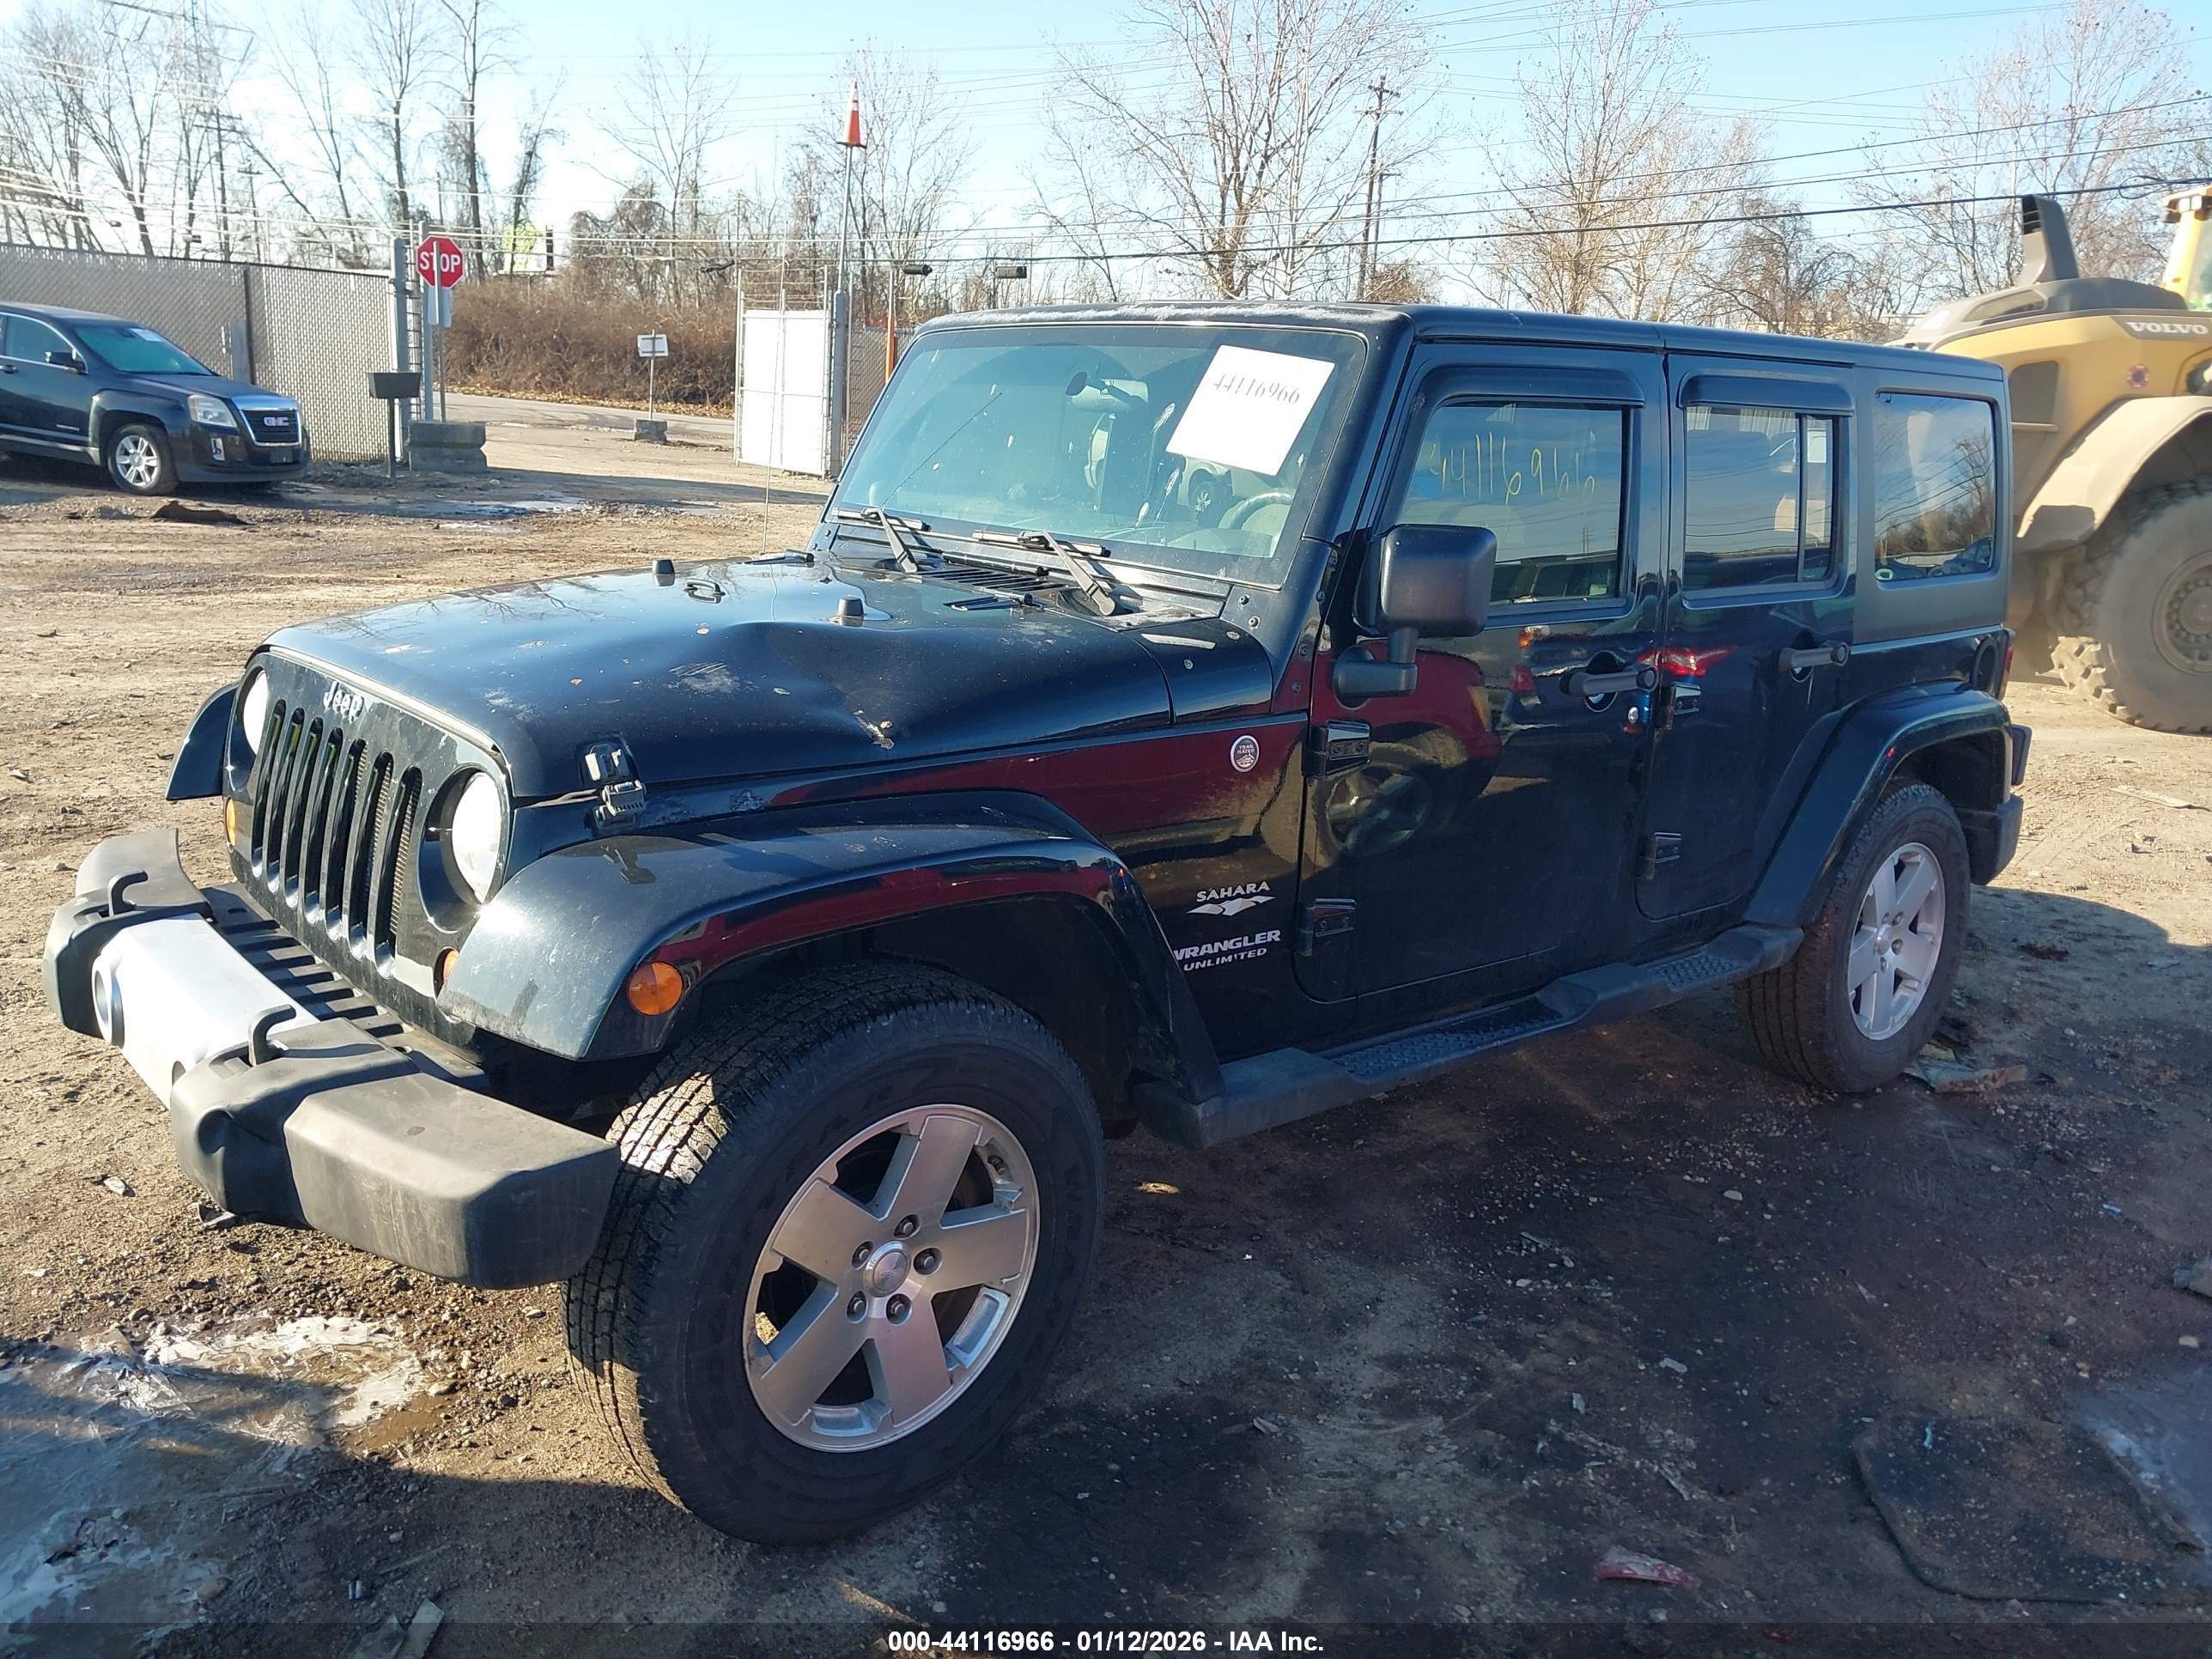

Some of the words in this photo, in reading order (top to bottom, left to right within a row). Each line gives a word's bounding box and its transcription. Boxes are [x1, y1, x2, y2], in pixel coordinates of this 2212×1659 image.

[2125, 321, 2209, 335] VOLVO
[1212, 374, 1300, 404] 44116966
[264, 416, 289, 427] GMC
[323, 680, 364, 723] Jeep
[1196, 881, 1270, 902] SAHARA
[1183, 948, 1267, 971] UNLIMITED
